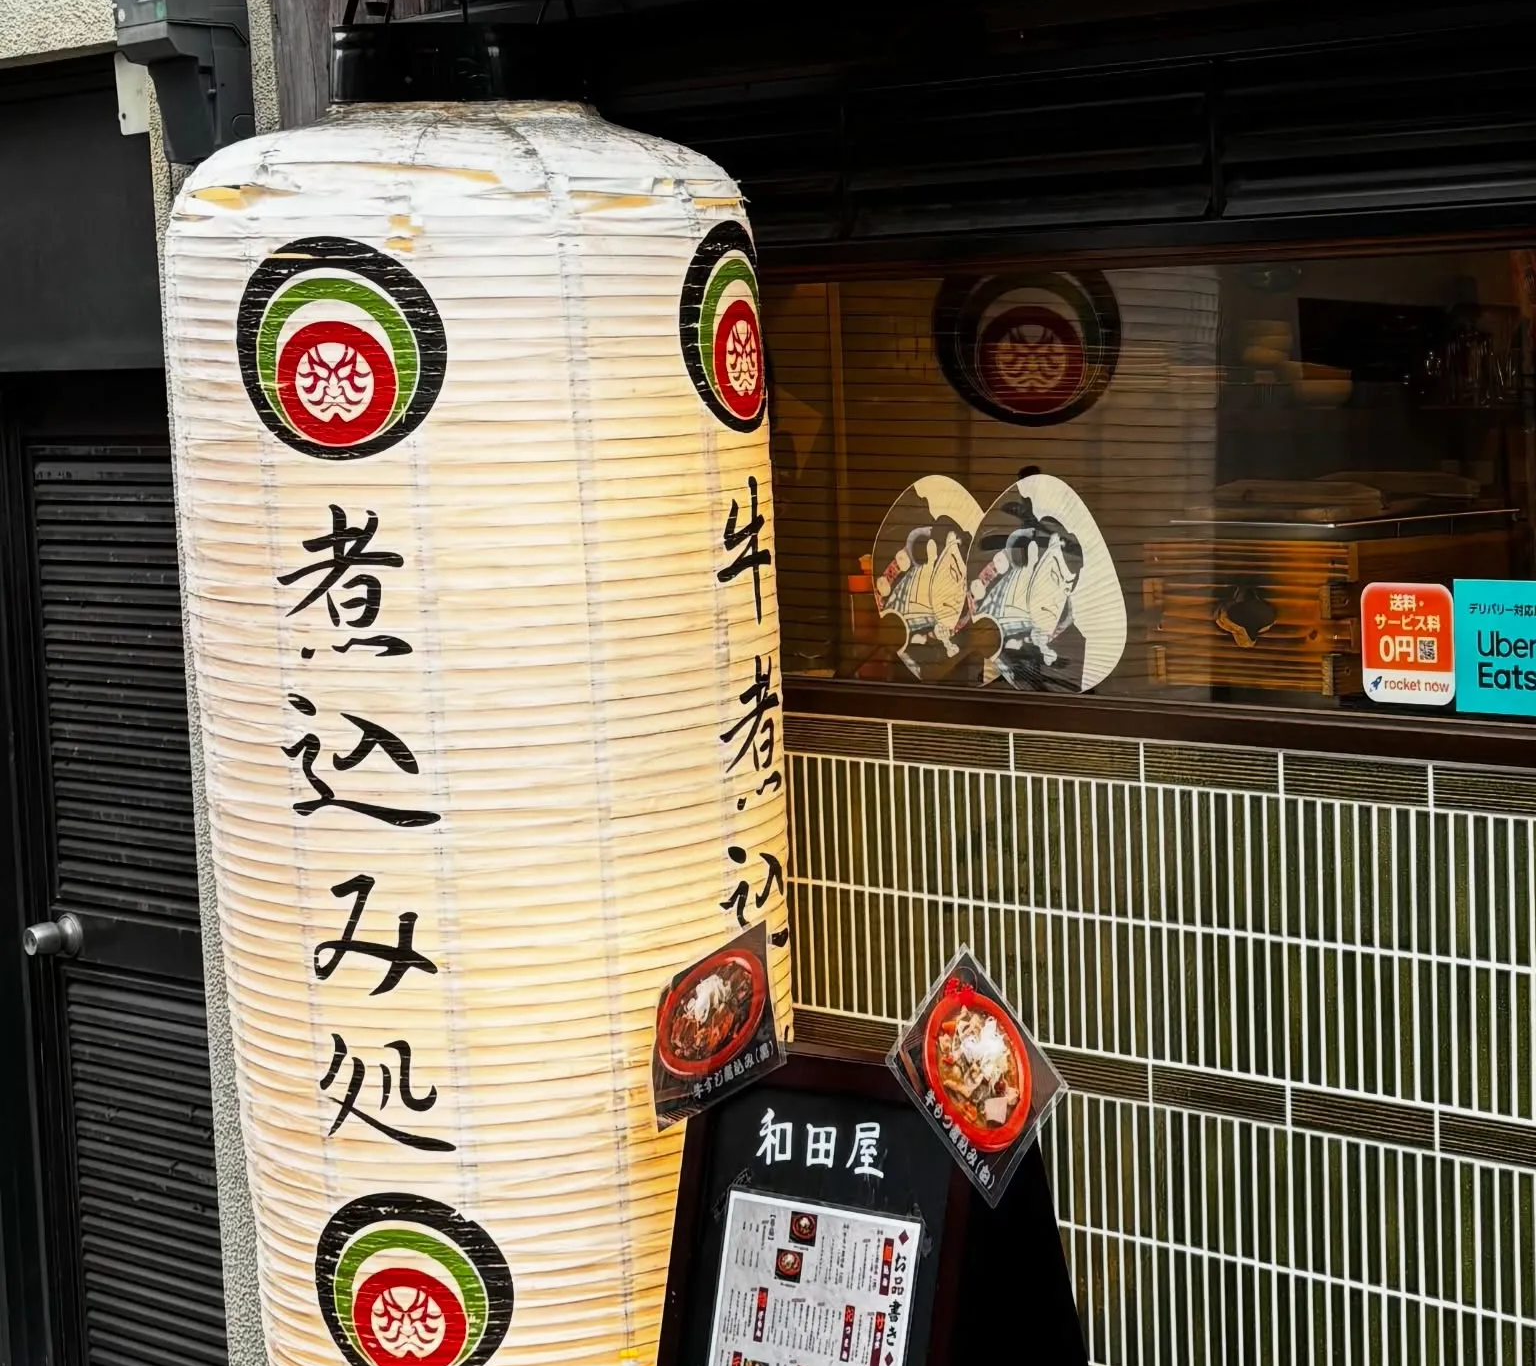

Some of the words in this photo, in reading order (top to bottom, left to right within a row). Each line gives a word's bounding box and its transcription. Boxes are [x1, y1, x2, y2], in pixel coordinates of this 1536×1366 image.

[1374, 614, 1441, 633] サービス料
[1378, 635, 1415, 663] 0円
[1383, 676, 1422, 693] rocket
[1424, 681, 1450, 694] now
[276, 502, 457, 1153] 煮込み処
[755, 1107, 885, 1180] 和田屋
[886, 1252, 909, 1348] お品書き
